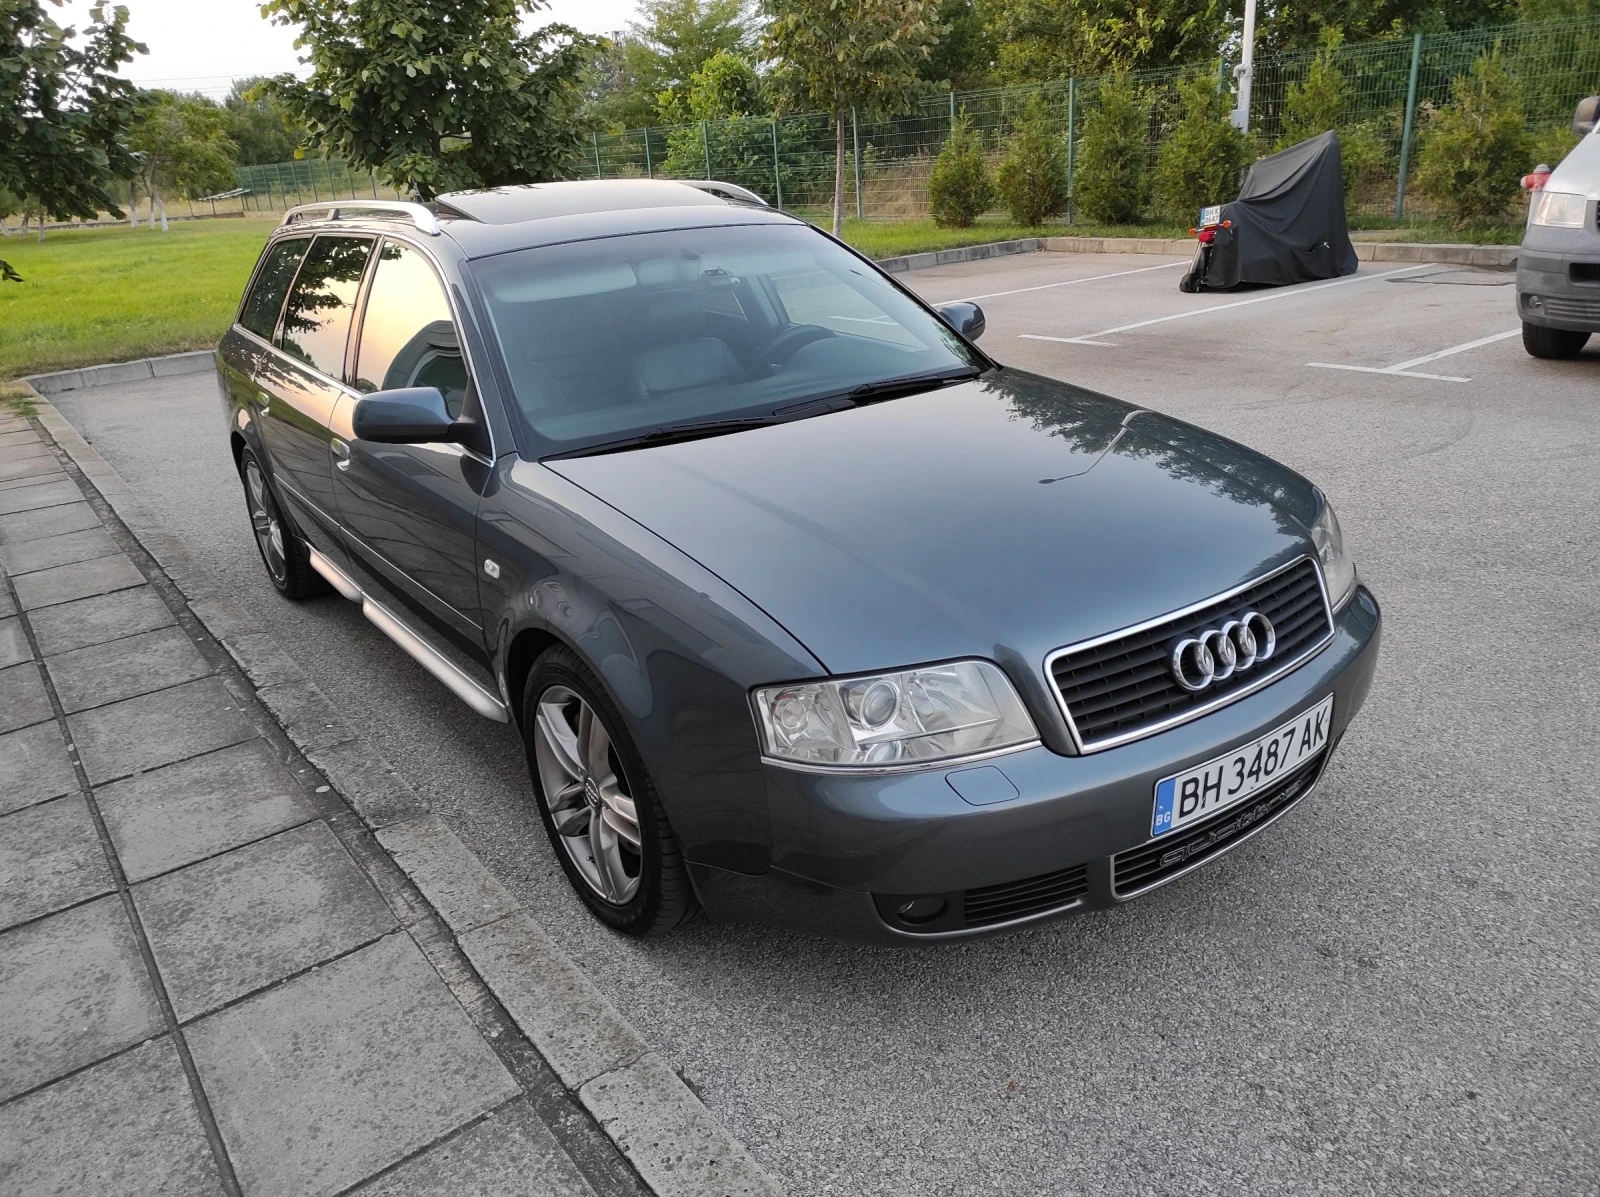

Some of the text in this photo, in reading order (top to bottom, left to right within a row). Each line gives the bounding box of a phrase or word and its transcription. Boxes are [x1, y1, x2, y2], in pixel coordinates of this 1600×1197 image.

[1204, 215, 1219, 223] 0647
[1179, 705, 1328, 819] BH 3487 AK
[1156, 811, 1171, 826] BG
